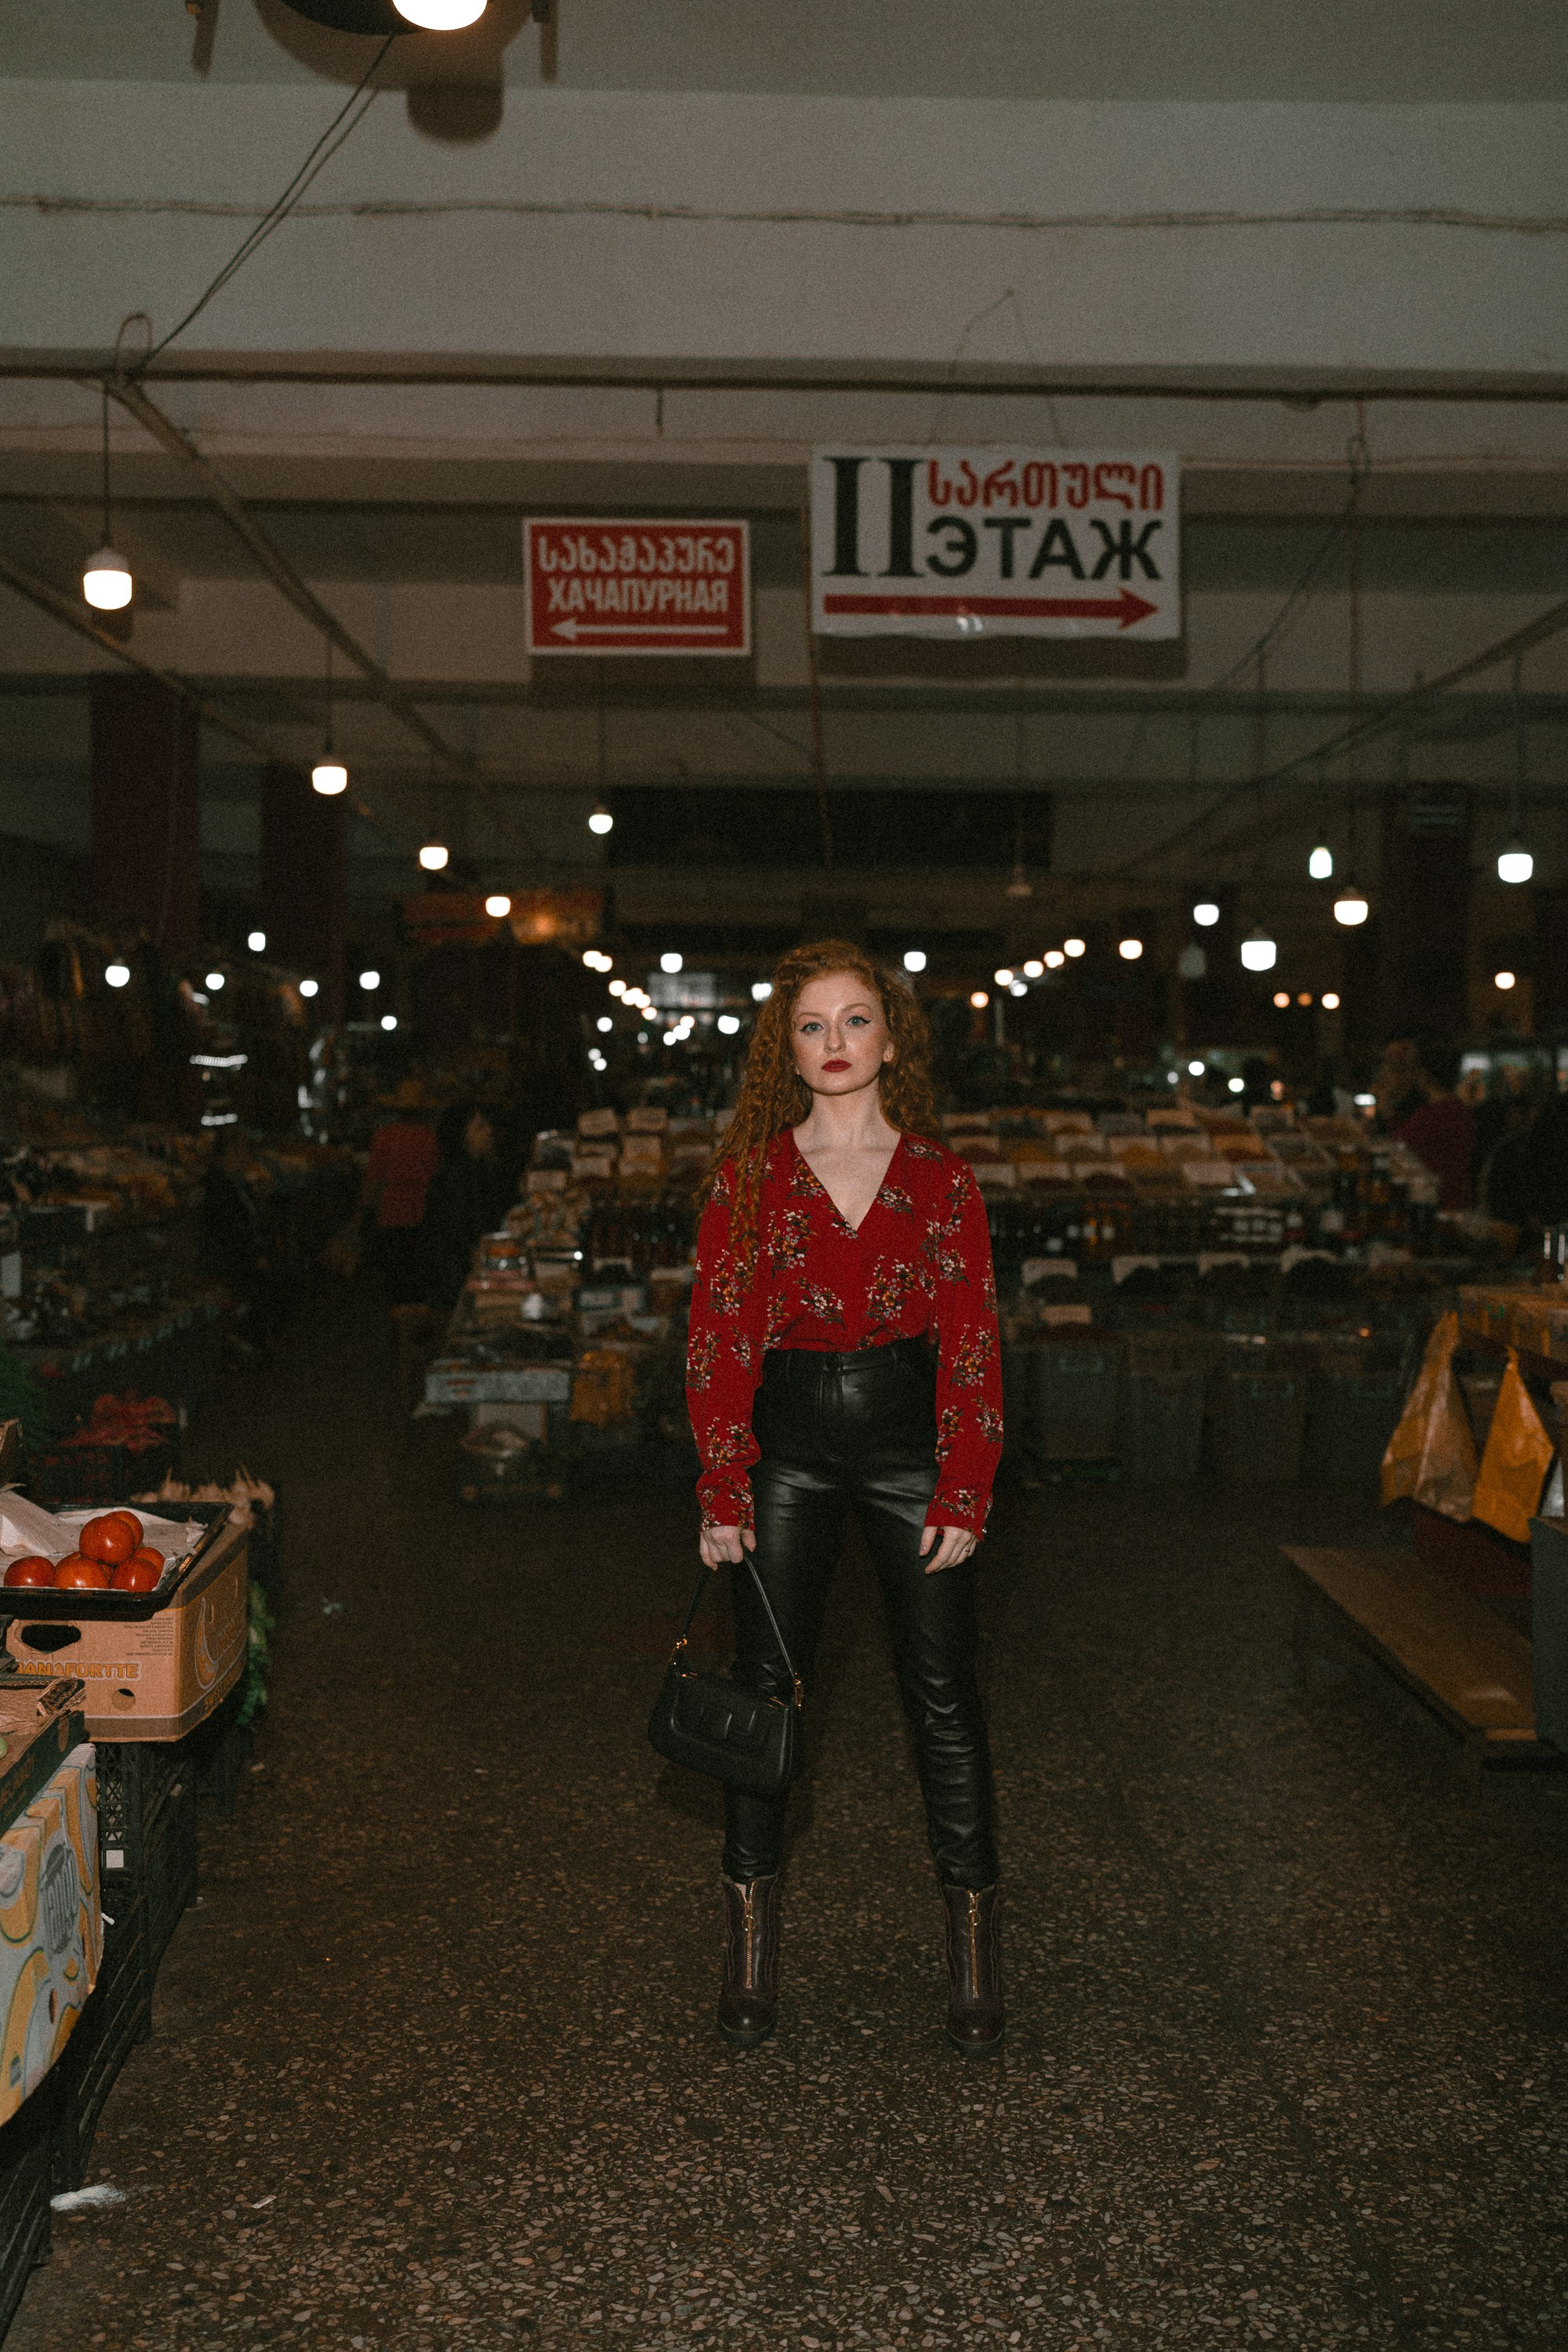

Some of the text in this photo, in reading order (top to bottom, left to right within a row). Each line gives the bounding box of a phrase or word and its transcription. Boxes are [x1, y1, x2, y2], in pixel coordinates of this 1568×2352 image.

[928, 459, 1164, 510] სართული
[927, 516, 1163, 580] ЭТАЖ
[548, 578, 729, 612] ХАЧАПУРНАЯ
